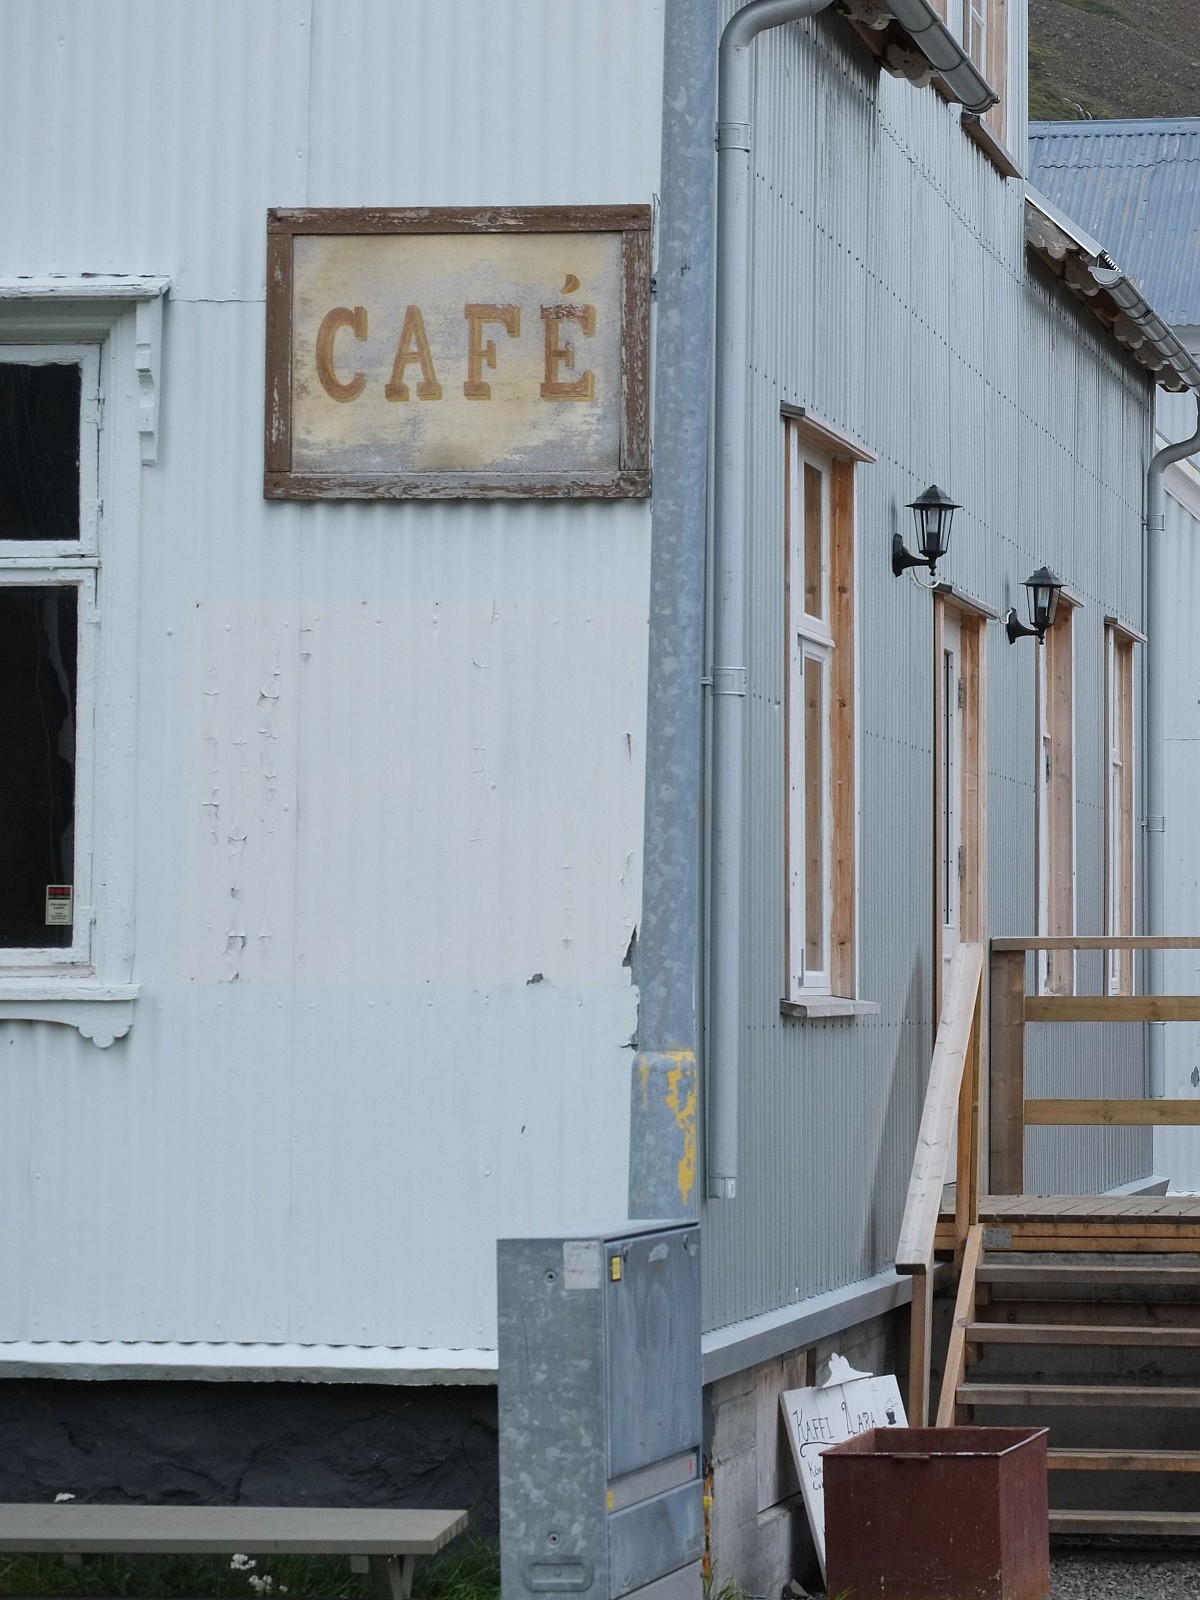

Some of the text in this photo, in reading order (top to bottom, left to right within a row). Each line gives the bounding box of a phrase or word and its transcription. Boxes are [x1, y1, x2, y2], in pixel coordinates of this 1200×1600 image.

[315, 273, 596, 403] CAFÉ
[792, 1401, 877, 1444] KAFFI LARA
